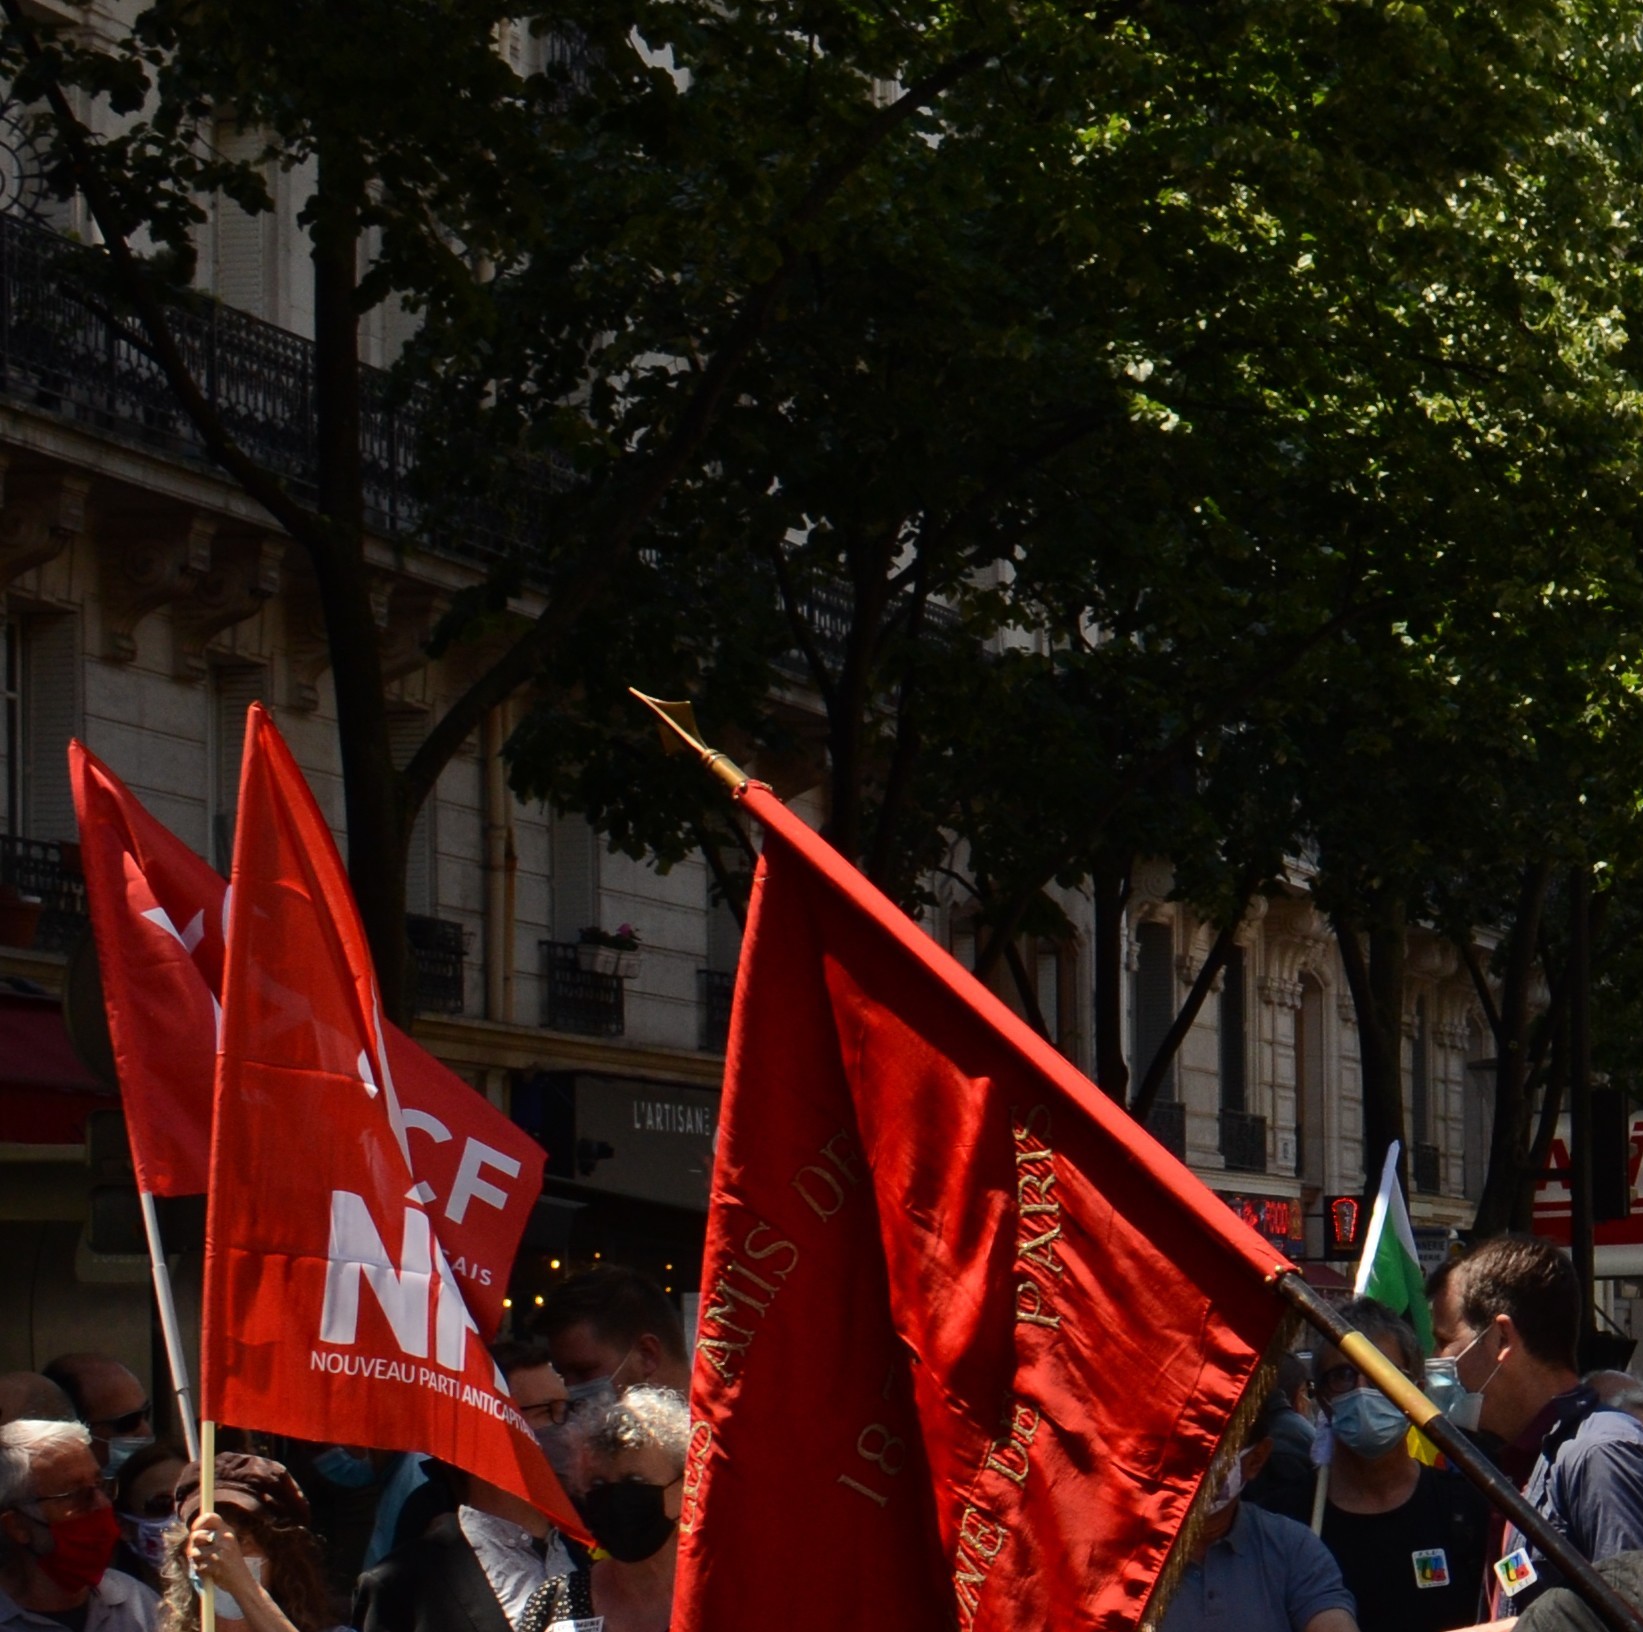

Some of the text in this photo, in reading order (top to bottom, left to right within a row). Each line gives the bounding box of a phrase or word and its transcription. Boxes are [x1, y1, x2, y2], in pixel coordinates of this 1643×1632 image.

[399, 1107, 523, 1226] CF
[452, 1257, 493, 1287] AIS
[696, 1220, 799, 1386] AMIS
[310, 1350, 540, 1446] NOUVEAU PARTI ANTICAPITA
